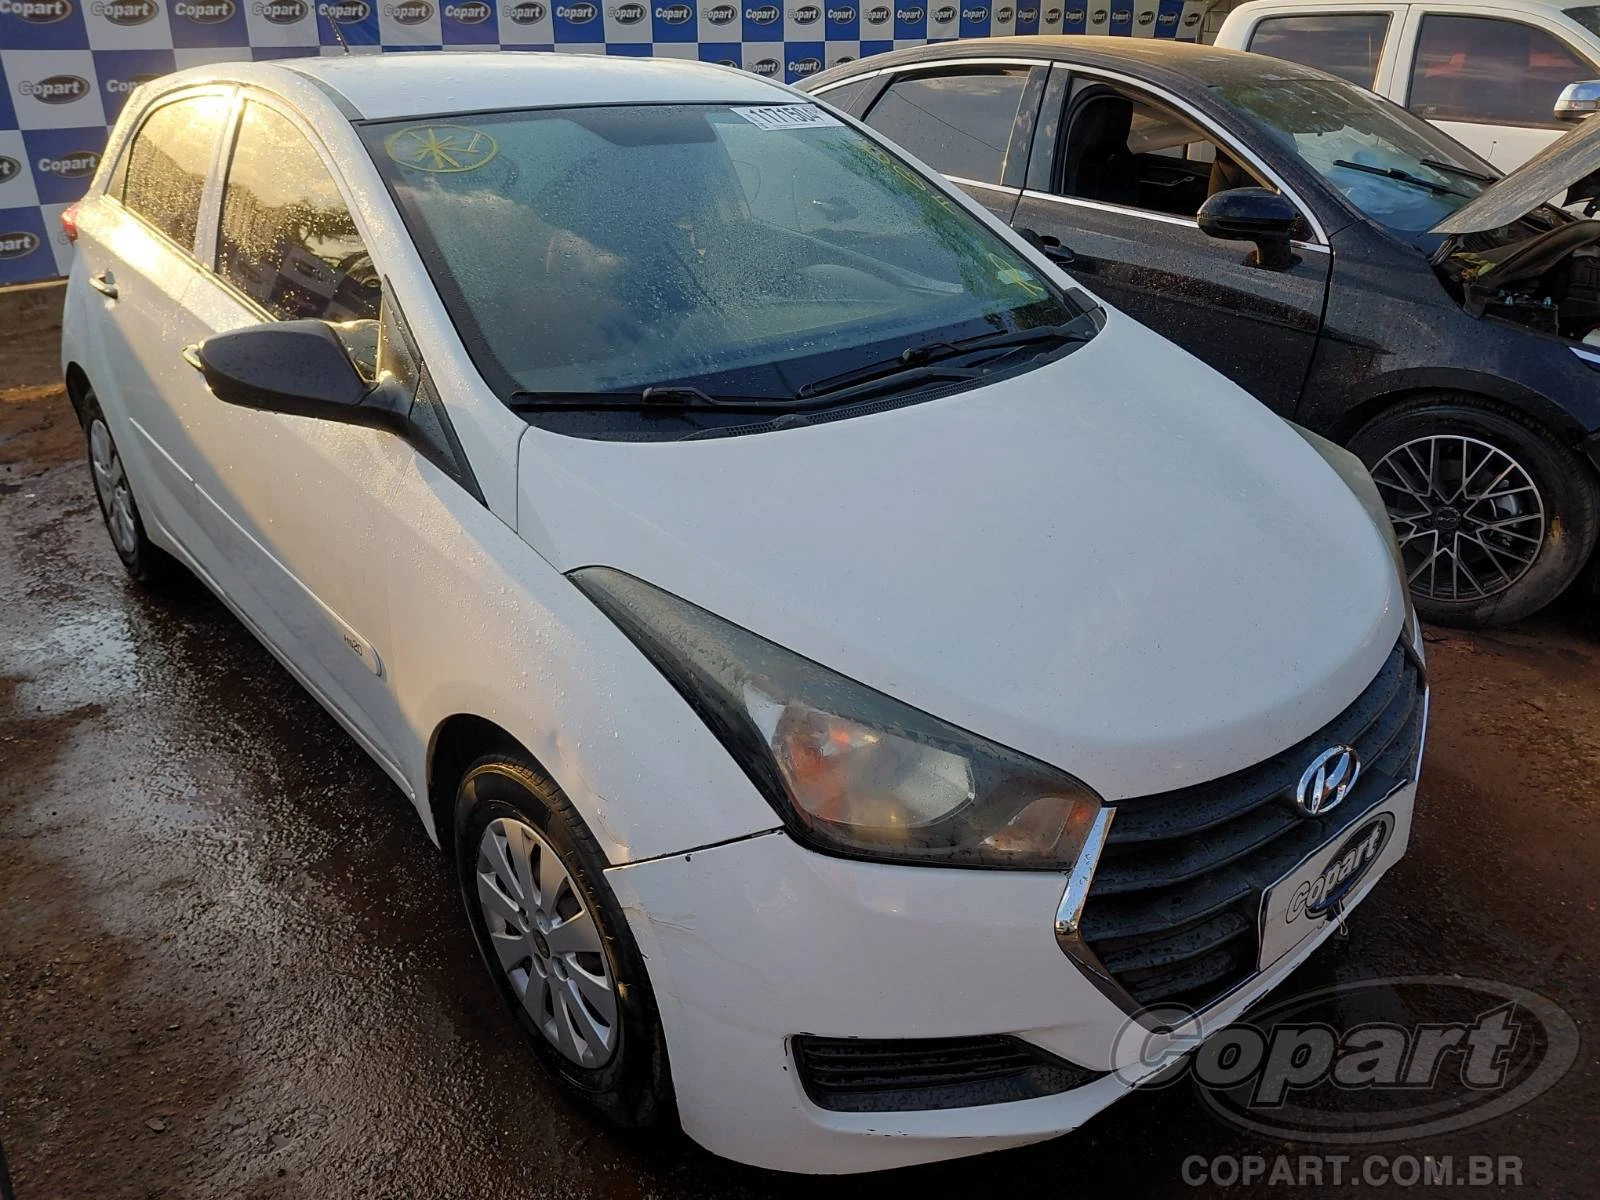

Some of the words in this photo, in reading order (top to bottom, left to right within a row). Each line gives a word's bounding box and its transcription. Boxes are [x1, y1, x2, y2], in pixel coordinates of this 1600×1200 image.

[0, 0, 63, 16] Copart
[91, 1, 149, 18] Copart
[175, 2, 228, 18] Copart
[252, 2, 301, 18] Copart
[318, 3, 365, 18] Copart
[384, 4, 426, 18] Copart
[445, 4, 485, 19] Copart
[502, 5, 541, 19] Copart
[556, 5, 593, 19] Copart
[608, 7, 642, 20] Copart
[655, 7, 688, 20] Copart
[702, 7, 734, 20] Copart
[745, 8, 775, 20] Copart
[788, 8, 818, 20] Copart
[828, 8, 853, 20] Copart
[863, 8, 888, 20] Copart
[897, 8, 921, 20] Copart
[930, 8, 954, 20] Copart
[962, 9, 985, 20] Copart
[748, 60, 776, 73] Copart
[788, 60, 817, 74] Copart
[19, 81, 80, 98] Copart
[38, 156, 96, 173] Copart
[1286, 820, 1383, 924] Copart
